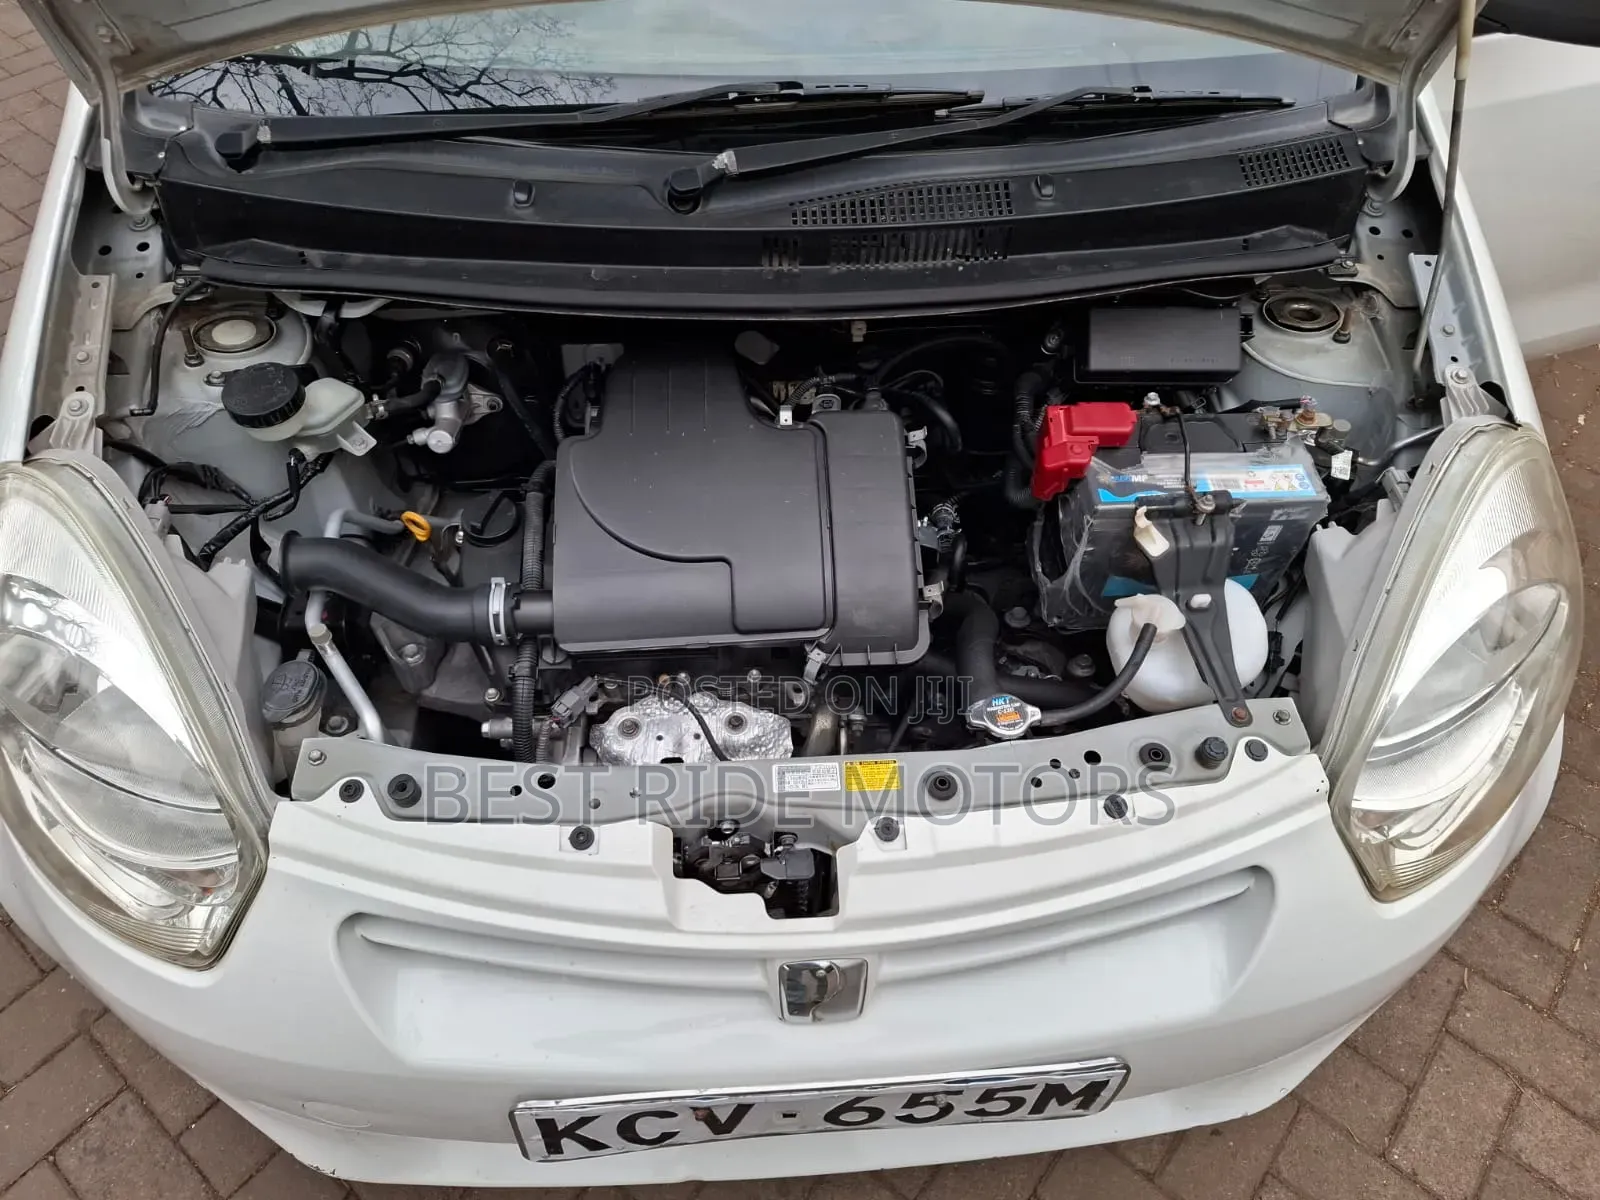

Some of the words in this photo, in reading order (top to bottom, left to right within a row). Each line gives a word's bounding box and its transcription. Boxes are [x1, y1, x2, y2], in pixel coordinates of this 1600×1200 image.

[992, 696, 1009, 706] HKT
[535, 1103, 755, 1155] KCV
[823, 1080, 1110, 1127] 655M
